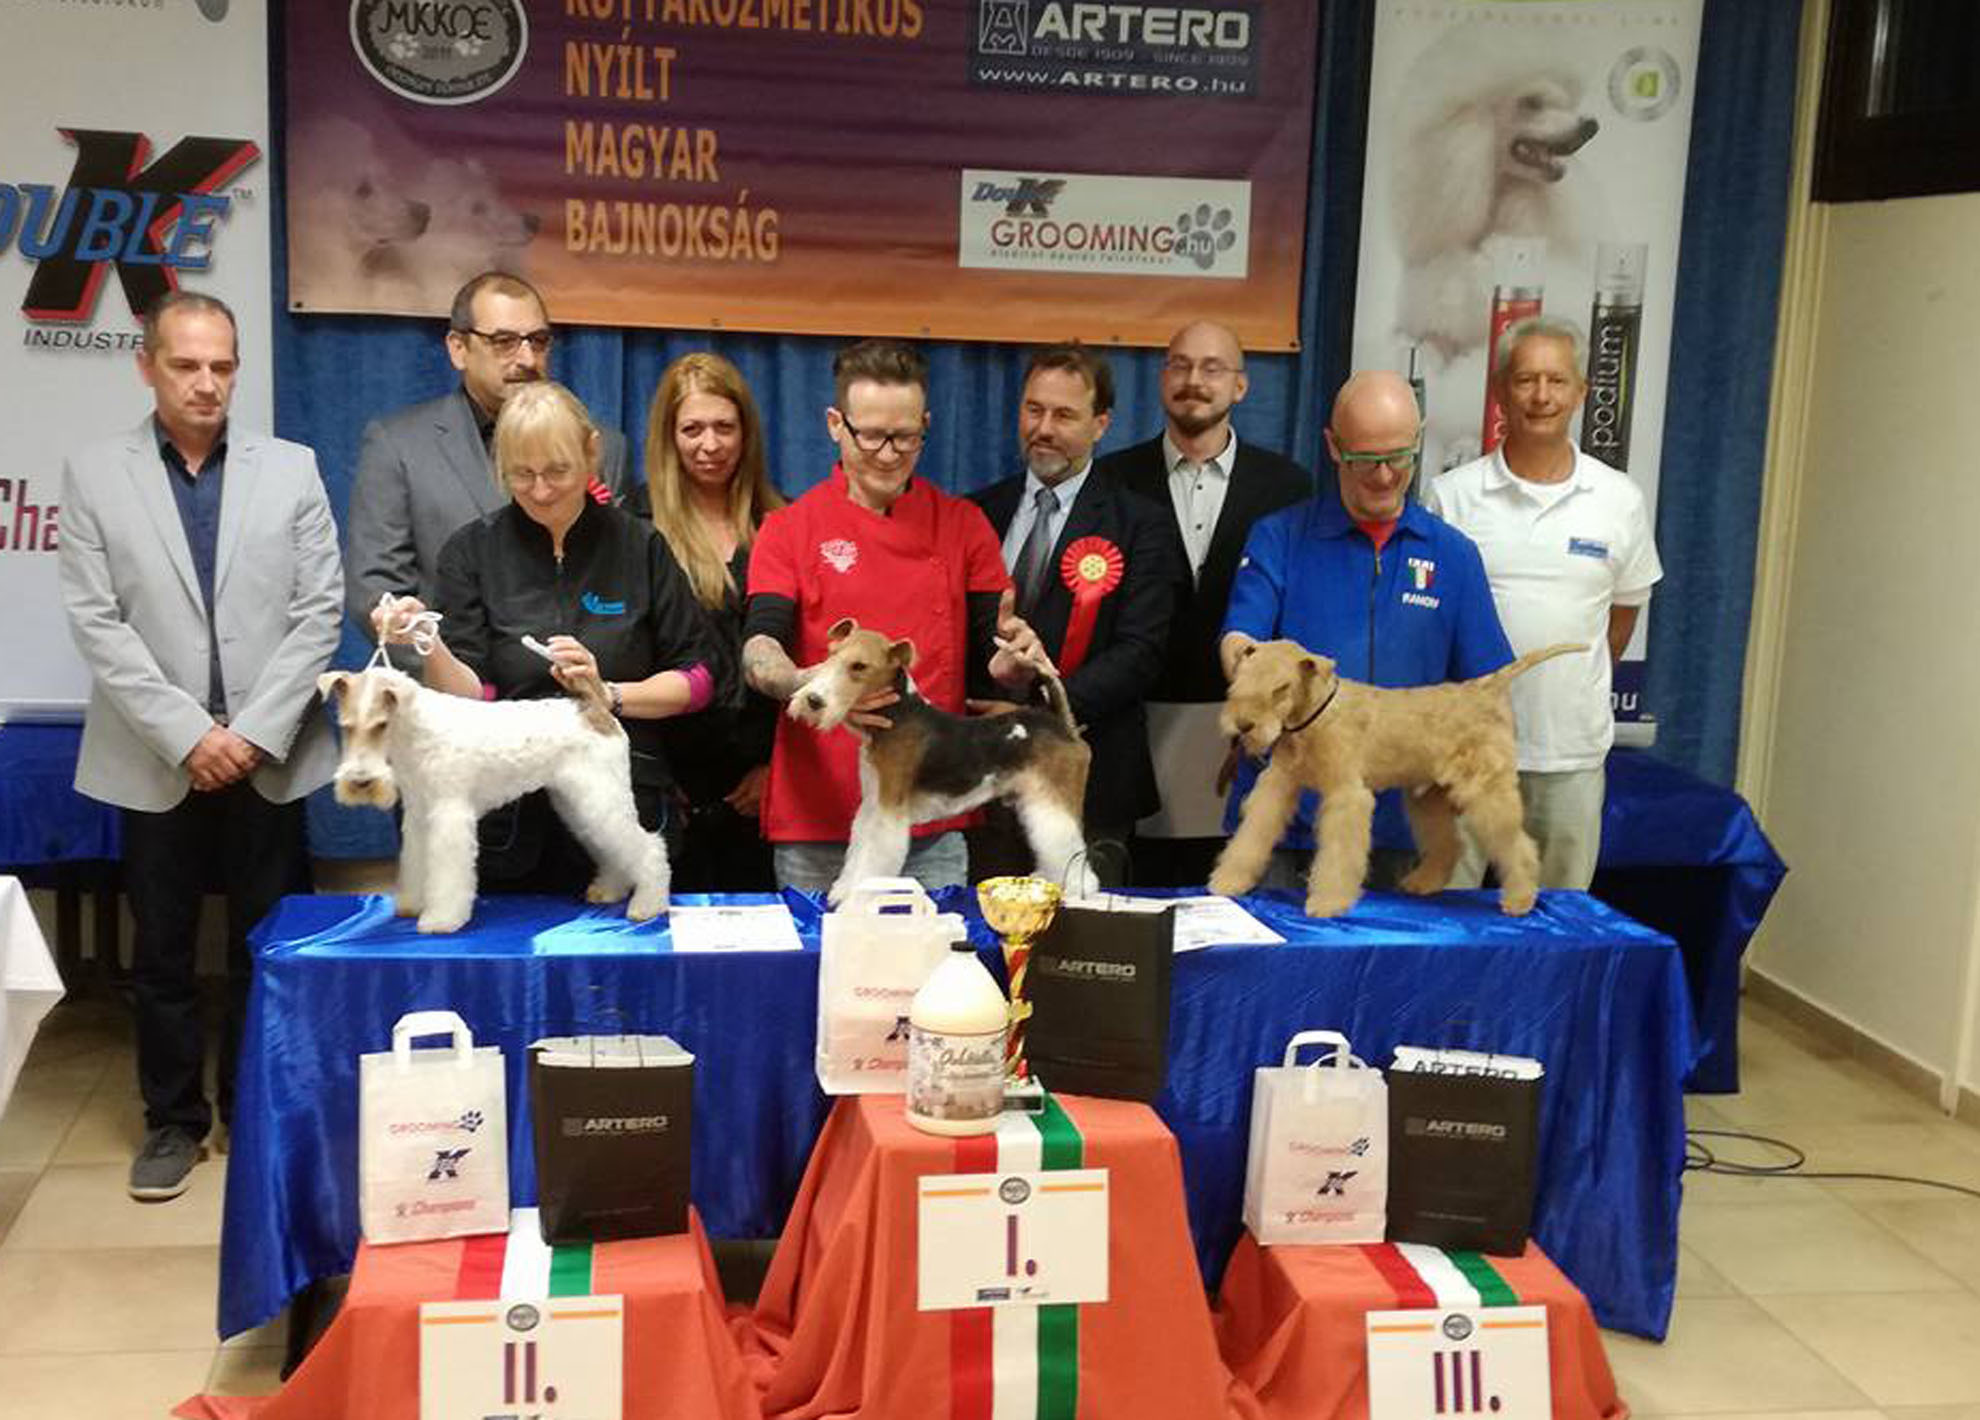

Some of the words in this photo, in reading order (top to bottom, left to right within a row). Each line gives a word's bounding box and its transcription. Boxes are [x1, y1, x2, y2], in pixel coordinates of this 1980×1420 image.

[566, 0, 924, 38] OZMETIKUS
[1034, 3, 1250, 49] ARTERO
[565, 26, 677, 100] NYÍLT
[979, 67, 1247, 94] www.ARTERO.hu
[565, 120, 719, 183] MAGYAR
[565, 189, 780, 262] BAJNOKSÁG
[991, 219, 1176, 254] GROOMING
[1591, 322, 1624, 449] podium
[1058, 960, 1137, 977] ARTERO
[584, 1115, 670, 1131] ARTERO
[1426, 1119, 1508, 1137] ARTERO
[503, 1340, 558, 1405] II.
[1433, 1350, 1502, 1414] III.
